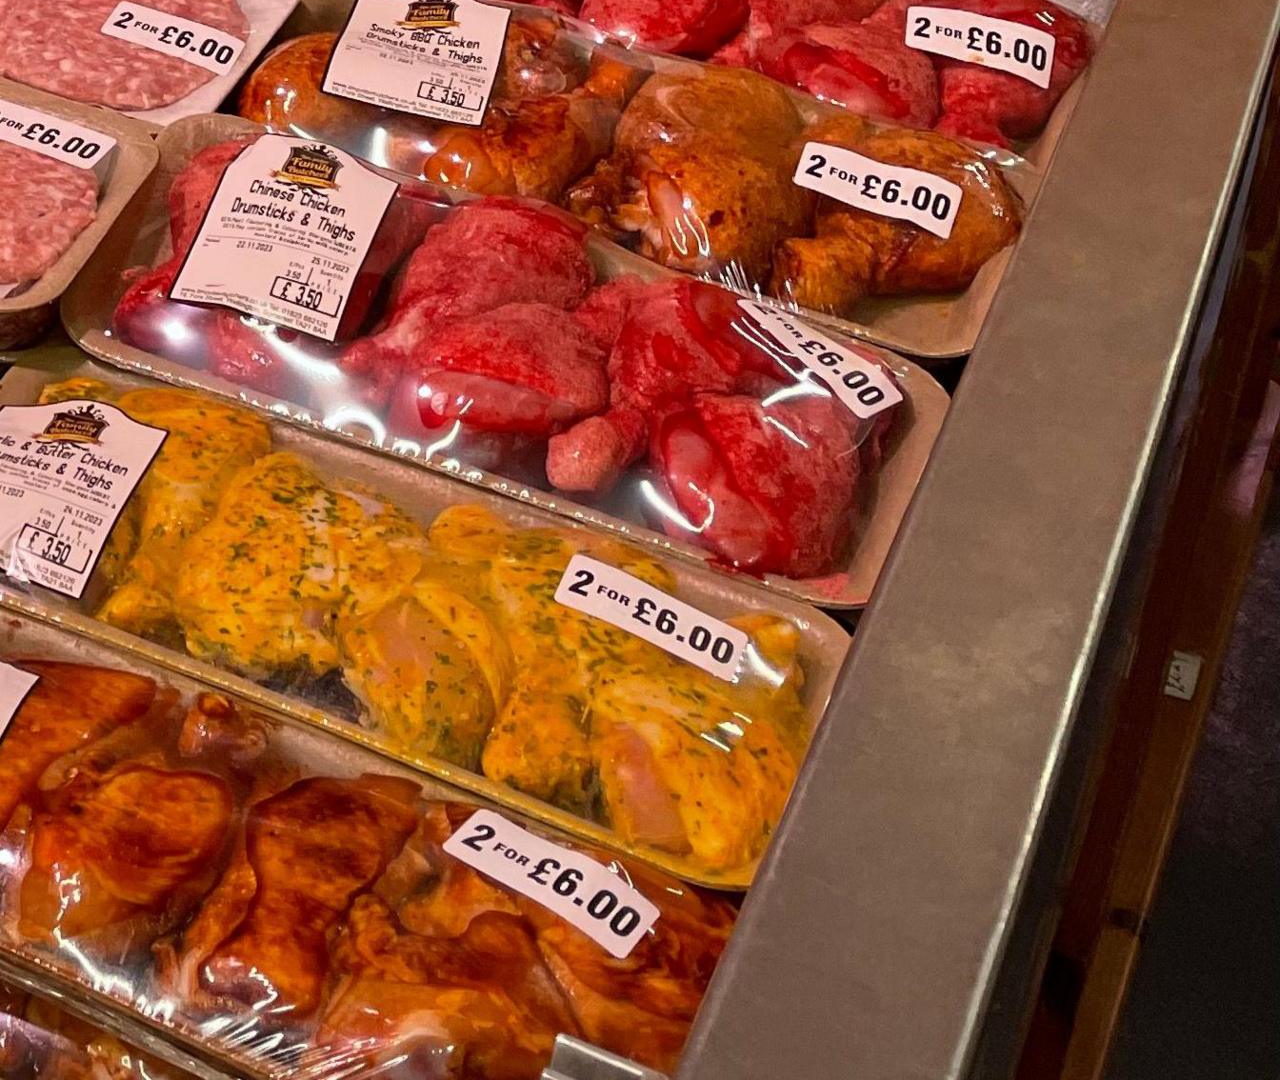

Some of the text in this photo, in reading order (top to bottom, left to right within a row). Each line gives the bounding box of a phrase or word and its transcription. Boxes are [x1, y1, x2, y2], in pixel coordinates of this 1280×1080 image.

[114, 11, 234, 65] 2 FOR £6.00
[913, 17, 1049, 72] 2 FOR £6.00
[0, 119, 25, 131] FOR
[21, 123, 101, 160] £6.00
[249, 179, 346, 217] Chinese Chicken
[805, 155, 951, 221] 2 FOR £6.00
[231, 197, 296, 222] Drumsticks
[301, 213, 311, 226] &
[317, 217, 356, 241] Thighs
[776, 316, 802, 340] FOR
[801, 339, 885, 407] £6.00
[21, 441, 31, 451] &
[36, 443, 76, 460] Butter
[79, 451, 129, 476] Chicken
[56, 463, 65, 474] &
[75, 465, 113, 491] Thighs
[28, 531, 72, 565] £ 3.50
[567, 568, 736, 665] 2 FOR £6.00
[461, 824, 642, 938] 2 FOR £6.00
